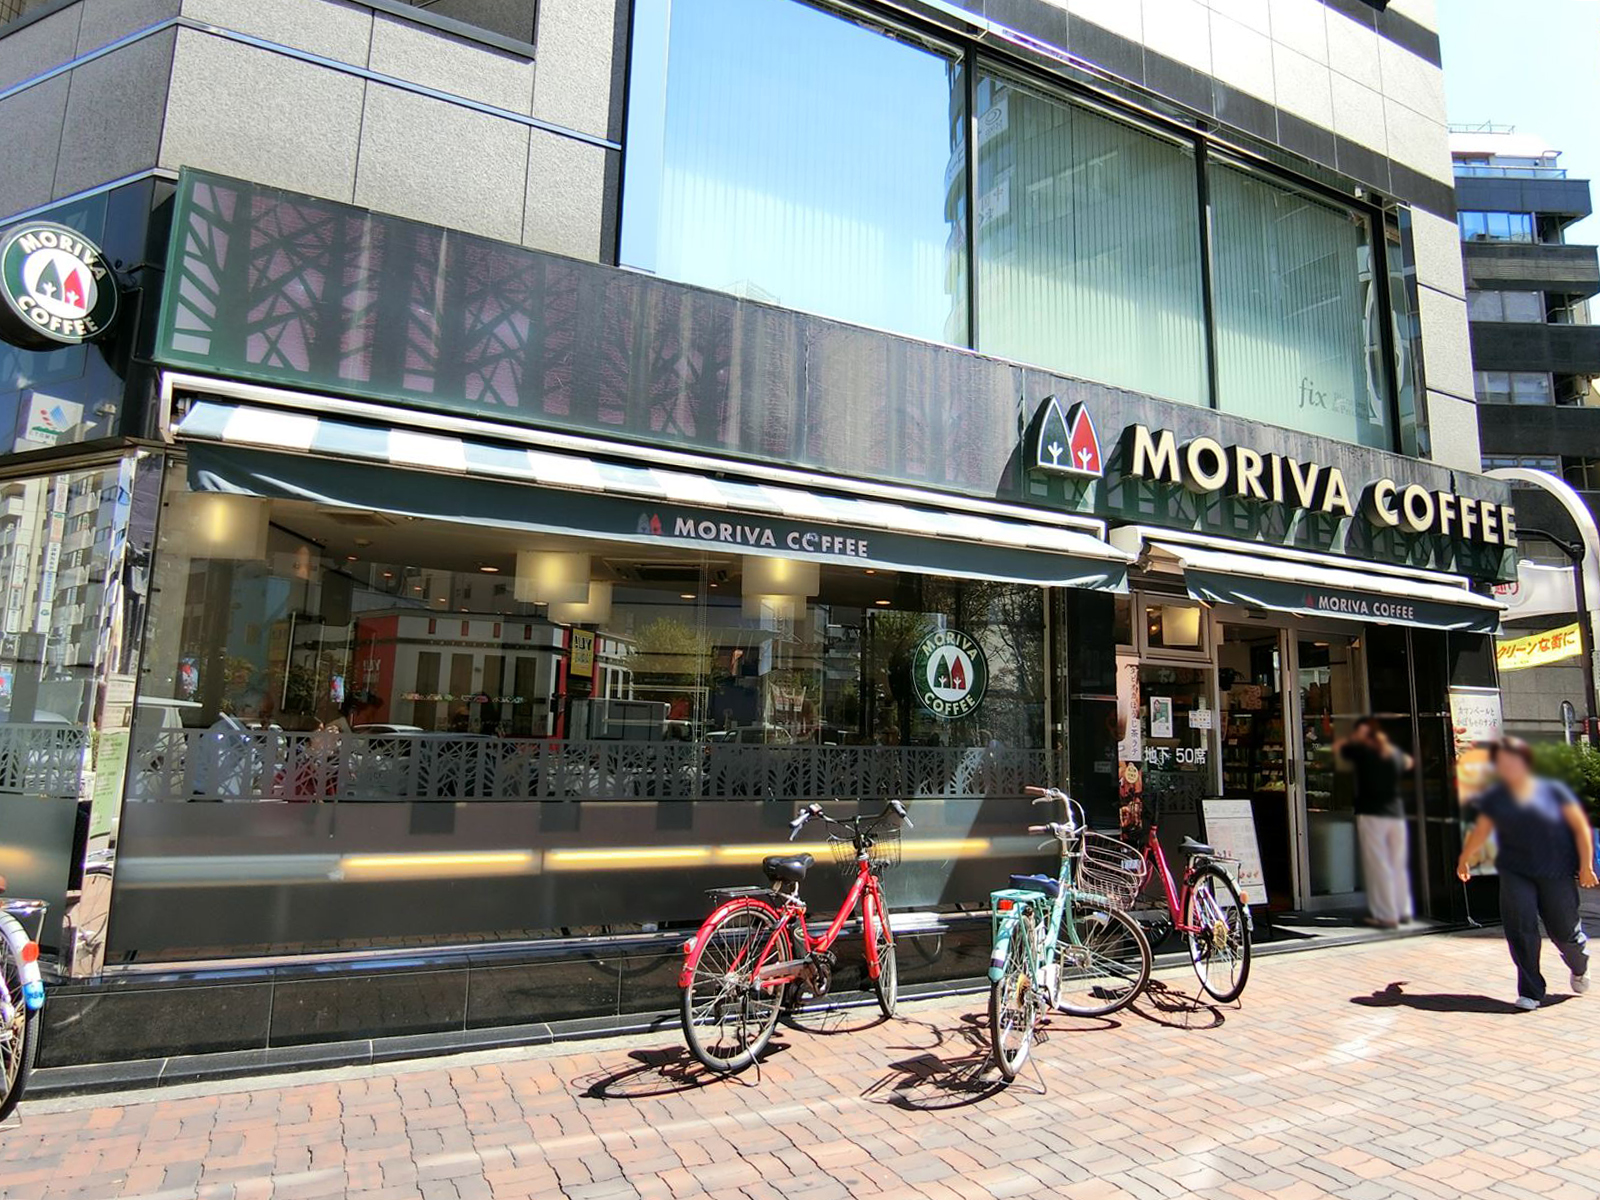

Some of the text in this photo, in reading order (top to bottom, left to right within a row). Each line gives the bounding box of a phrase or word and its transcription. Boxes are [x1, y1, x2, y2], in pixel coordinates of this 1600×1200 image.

[19, 231, 107, 281] MORIVA
[18, 296, 99, 335] COFFEE
[1299, 377, 1327, 409] fix
[1131, 425, 1518, 547] MORIVA COFFEE
[674, 517, 868, 557] MORIVA COFFEE
[1318, 596, 1414, 619] MORIVA COFFEE
[922, 631, 978, 661] MORIVA
[924, 692, 976, 715] COFFEE
[1144, 746, 1204, 765] 地下 50席
